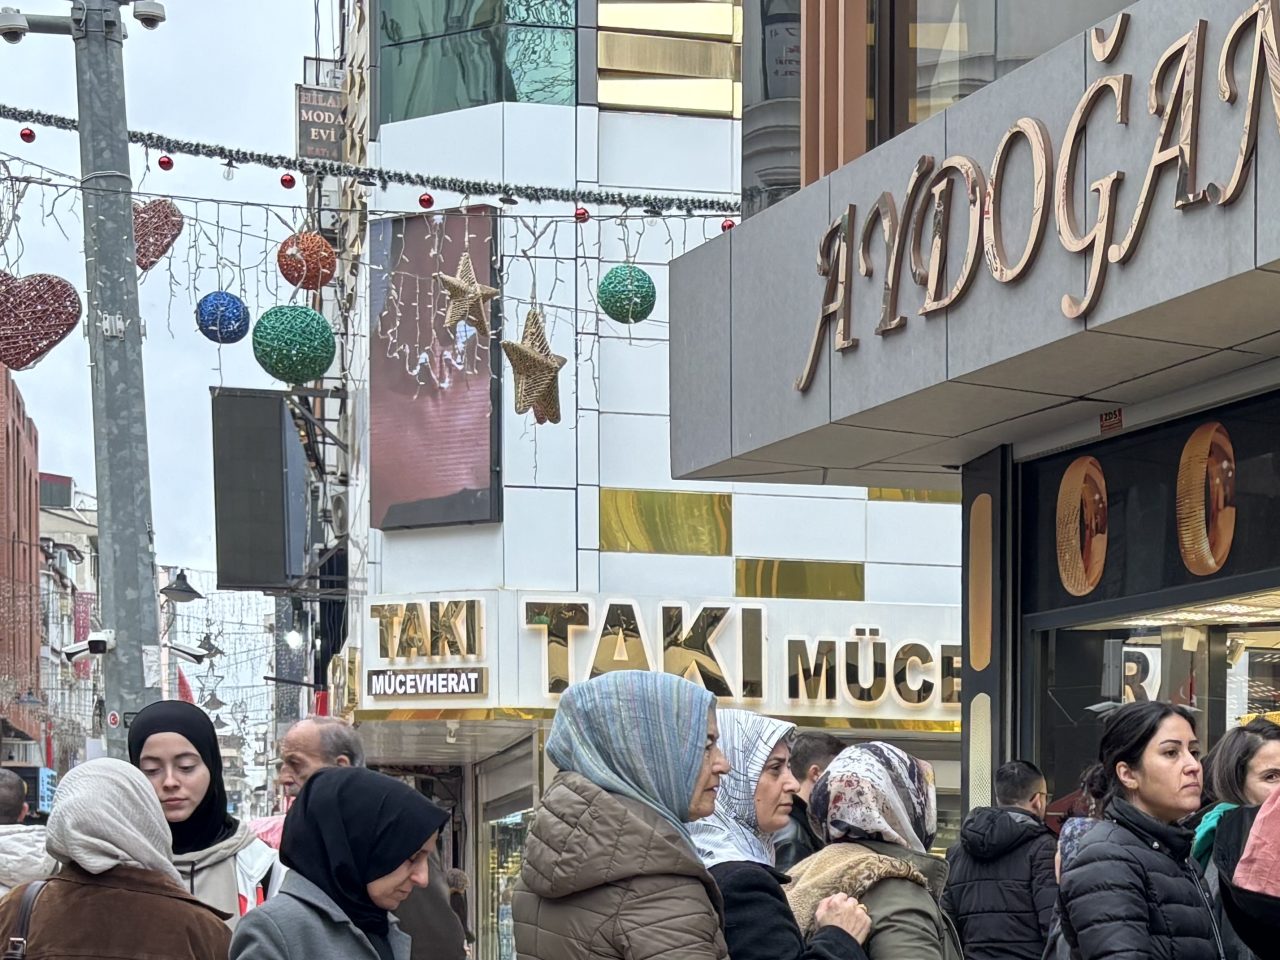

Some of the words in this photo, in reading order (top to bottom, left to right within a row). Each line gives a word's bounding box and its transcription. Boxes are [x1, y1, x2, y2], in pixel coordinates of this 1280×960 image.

[302, 109, 345, 125] MODA
[310, 127, 336, 142] EVİ
[371, 599, 480, 660] TAKI
[525, 603, 764, 699] TAKI
[371, 670, 478, 696] MÜCEVHERAT
